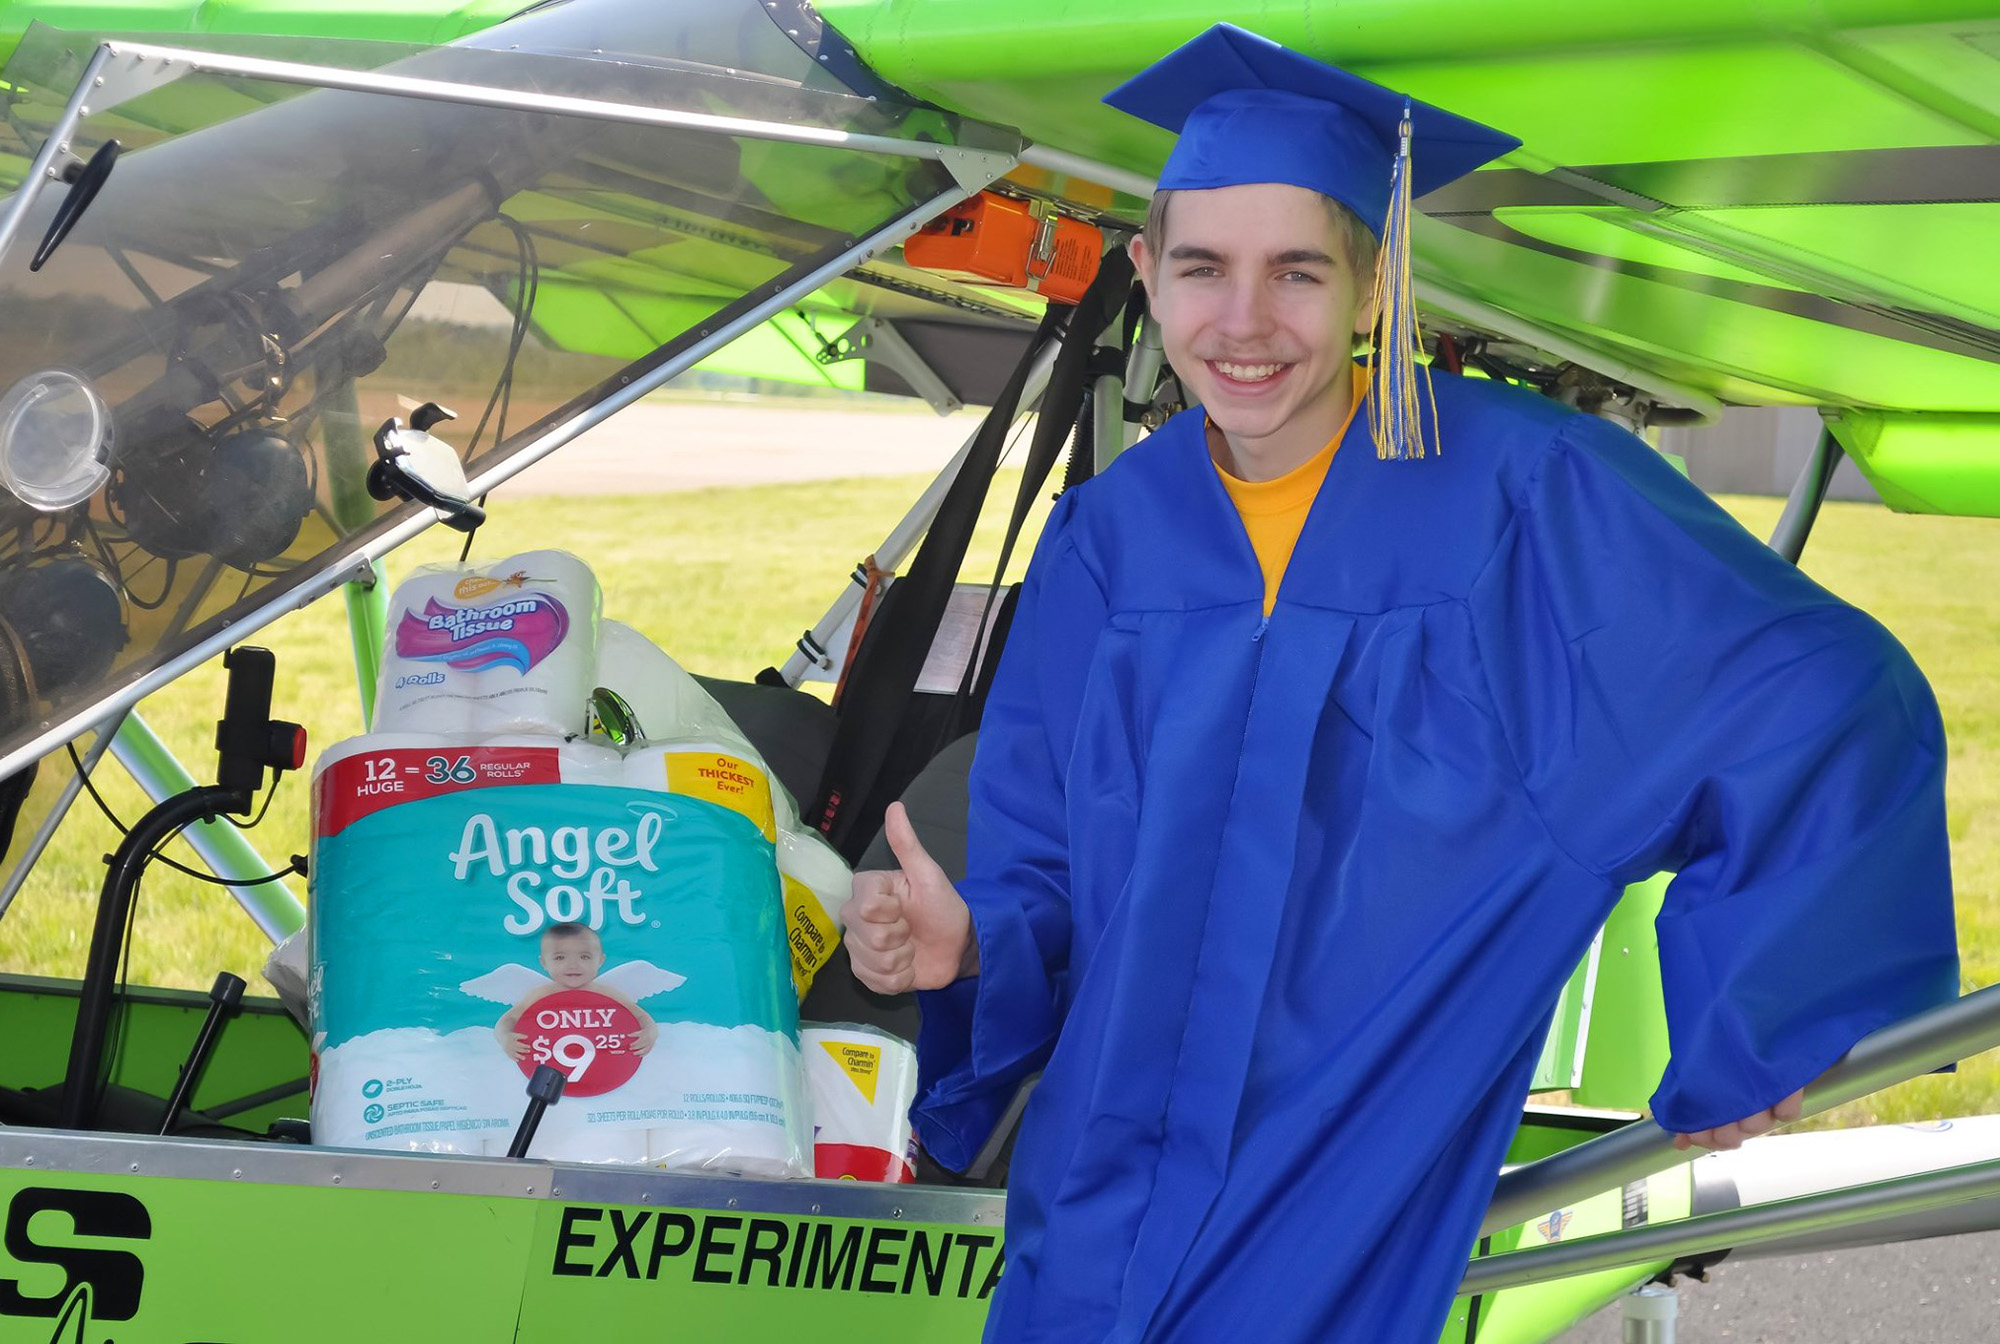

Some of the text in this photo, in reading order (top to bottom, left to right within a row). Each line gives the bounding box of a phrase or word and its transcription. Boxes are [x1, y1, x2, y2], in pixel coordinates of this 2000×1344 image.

[428, 600, 538, 630] Bathroom
[450, 618, 514, 642] Tissue
[407, 672, 445, 686] Rolls
[365, 757, 396, 782] 12
[425, 755, 477, 784] 36
[480, 762, 531, 771] REGULAR
[717, 758, 738, 770] Our
[698, 768, 755, 788] THICKEST
[357, 781, 404, 797] HUGE
[717, 781, 744, 794] Ever!
[449, 812, 662, 881] Angel
[503, 867, 646, 935] Soft
[794, 905, 824, 947] Compare
[789, 927, 817, 968] Charmin
[536, 1009, 616, 1029] ONLY
[842, 1047, 869, 1059] Compare
[847, 1057, 874, 1068] Charmin
[386, 1077, 413, 1087] 2-PLY
[387, 1099, 444, 1112] SEPTIC SAFE
